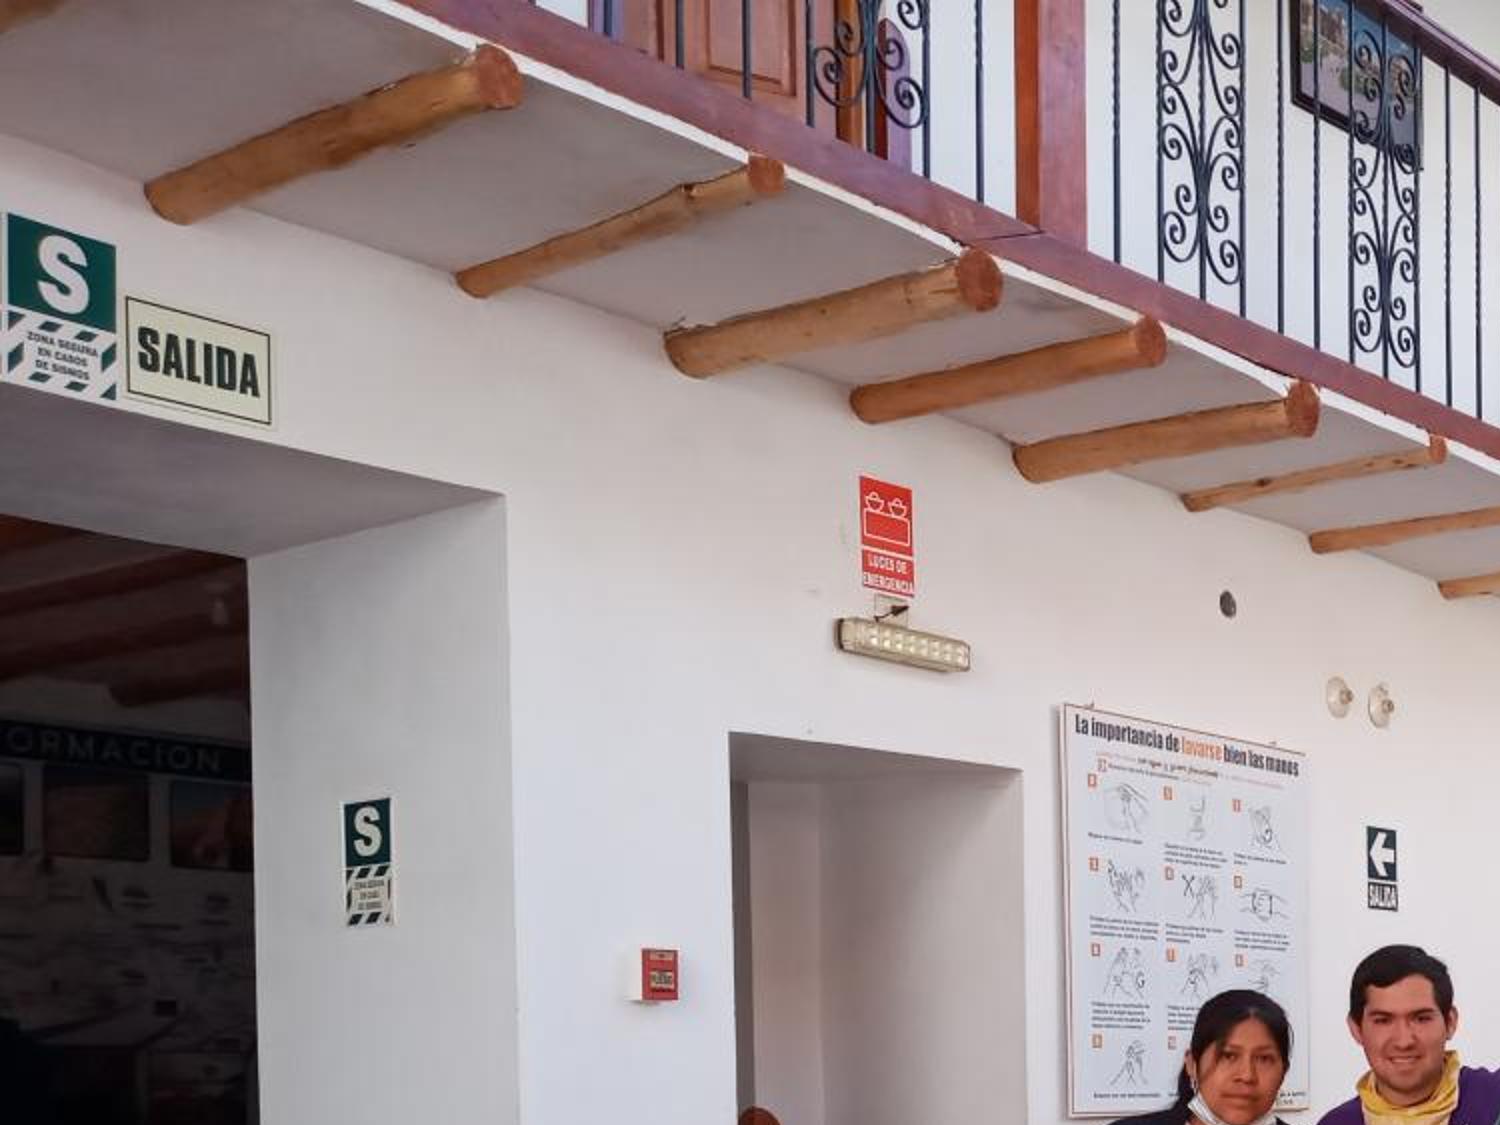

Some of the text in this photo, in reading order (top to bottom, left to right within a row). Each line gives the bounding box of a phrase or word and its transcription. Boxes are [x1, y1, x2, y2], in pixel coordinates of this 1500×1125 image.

[38, 234, 90, 315] S
[27, 330, 55, 345] ZONA
[37, 346, 51, 358] EN
[35, 359, 49, 371] DE
[137, 326, 261, 399] SALIDA
[0, 725, 222, 772] ORMACION
[1075, 713, 1089, 735] La
[1091, 717, 1164, 750] importancia
[1165, 732, 1179, 752] de
[1223, 743, 1247, 767] bien
[1247, 749, 1265, 769] las
[353, 805, 382, 857] S
